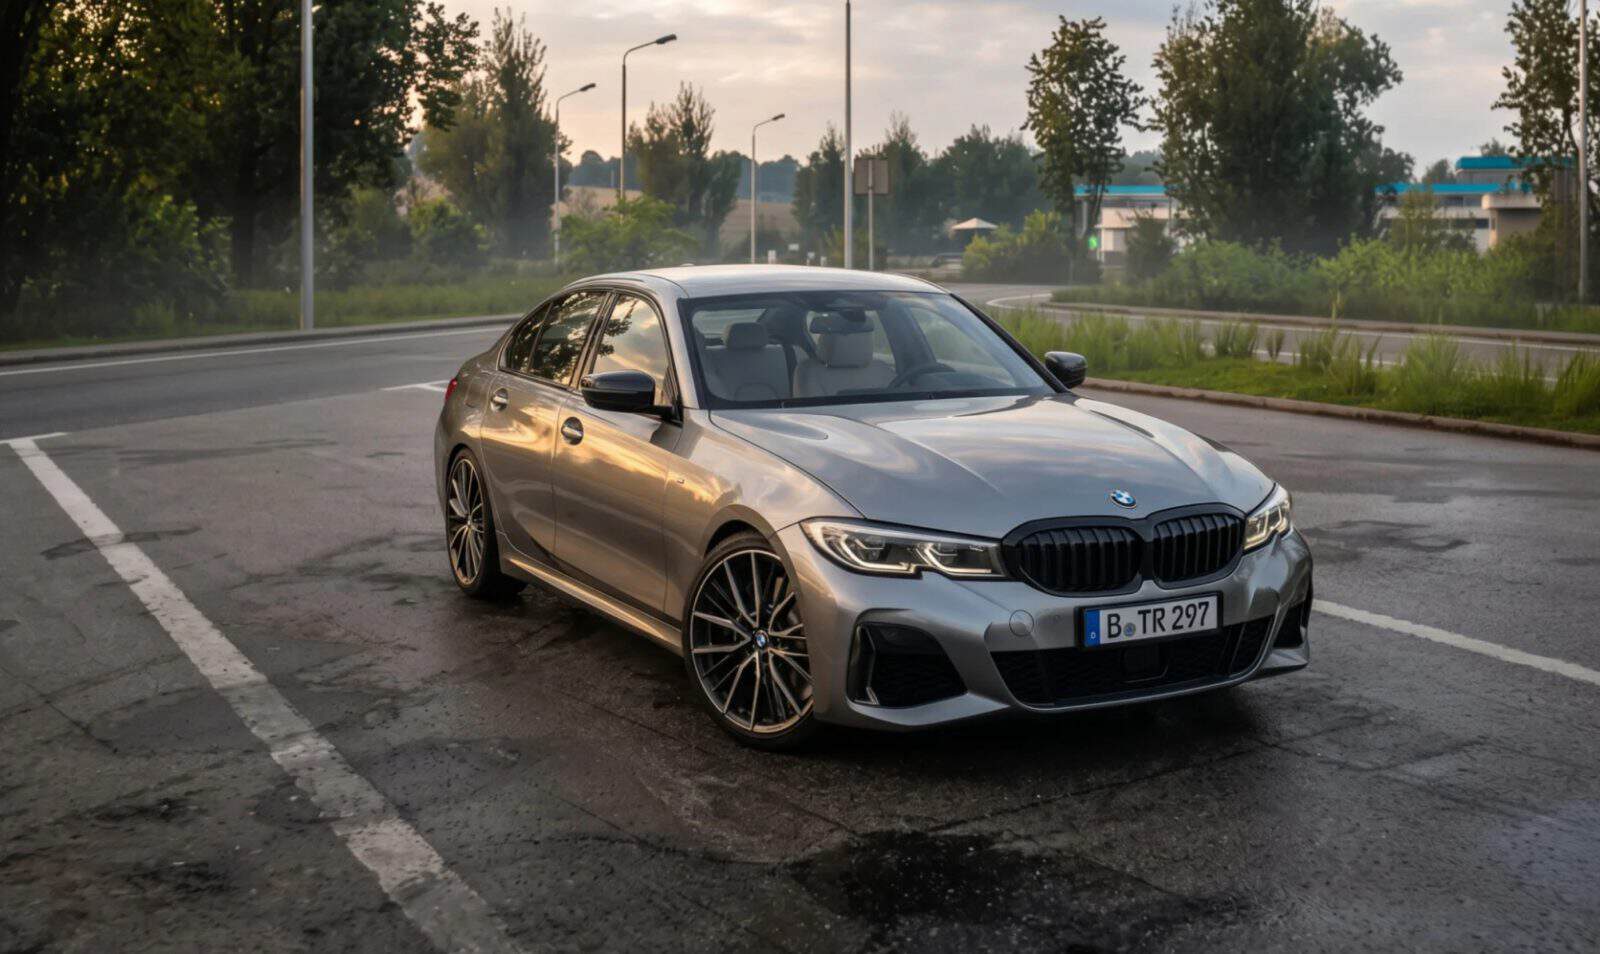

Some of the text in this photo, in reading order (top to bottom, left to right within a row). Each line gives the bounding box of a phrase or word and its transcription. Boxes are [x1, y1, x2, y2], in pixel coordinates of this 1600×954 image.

[1107, 601, 1209, 638] B TR 297
